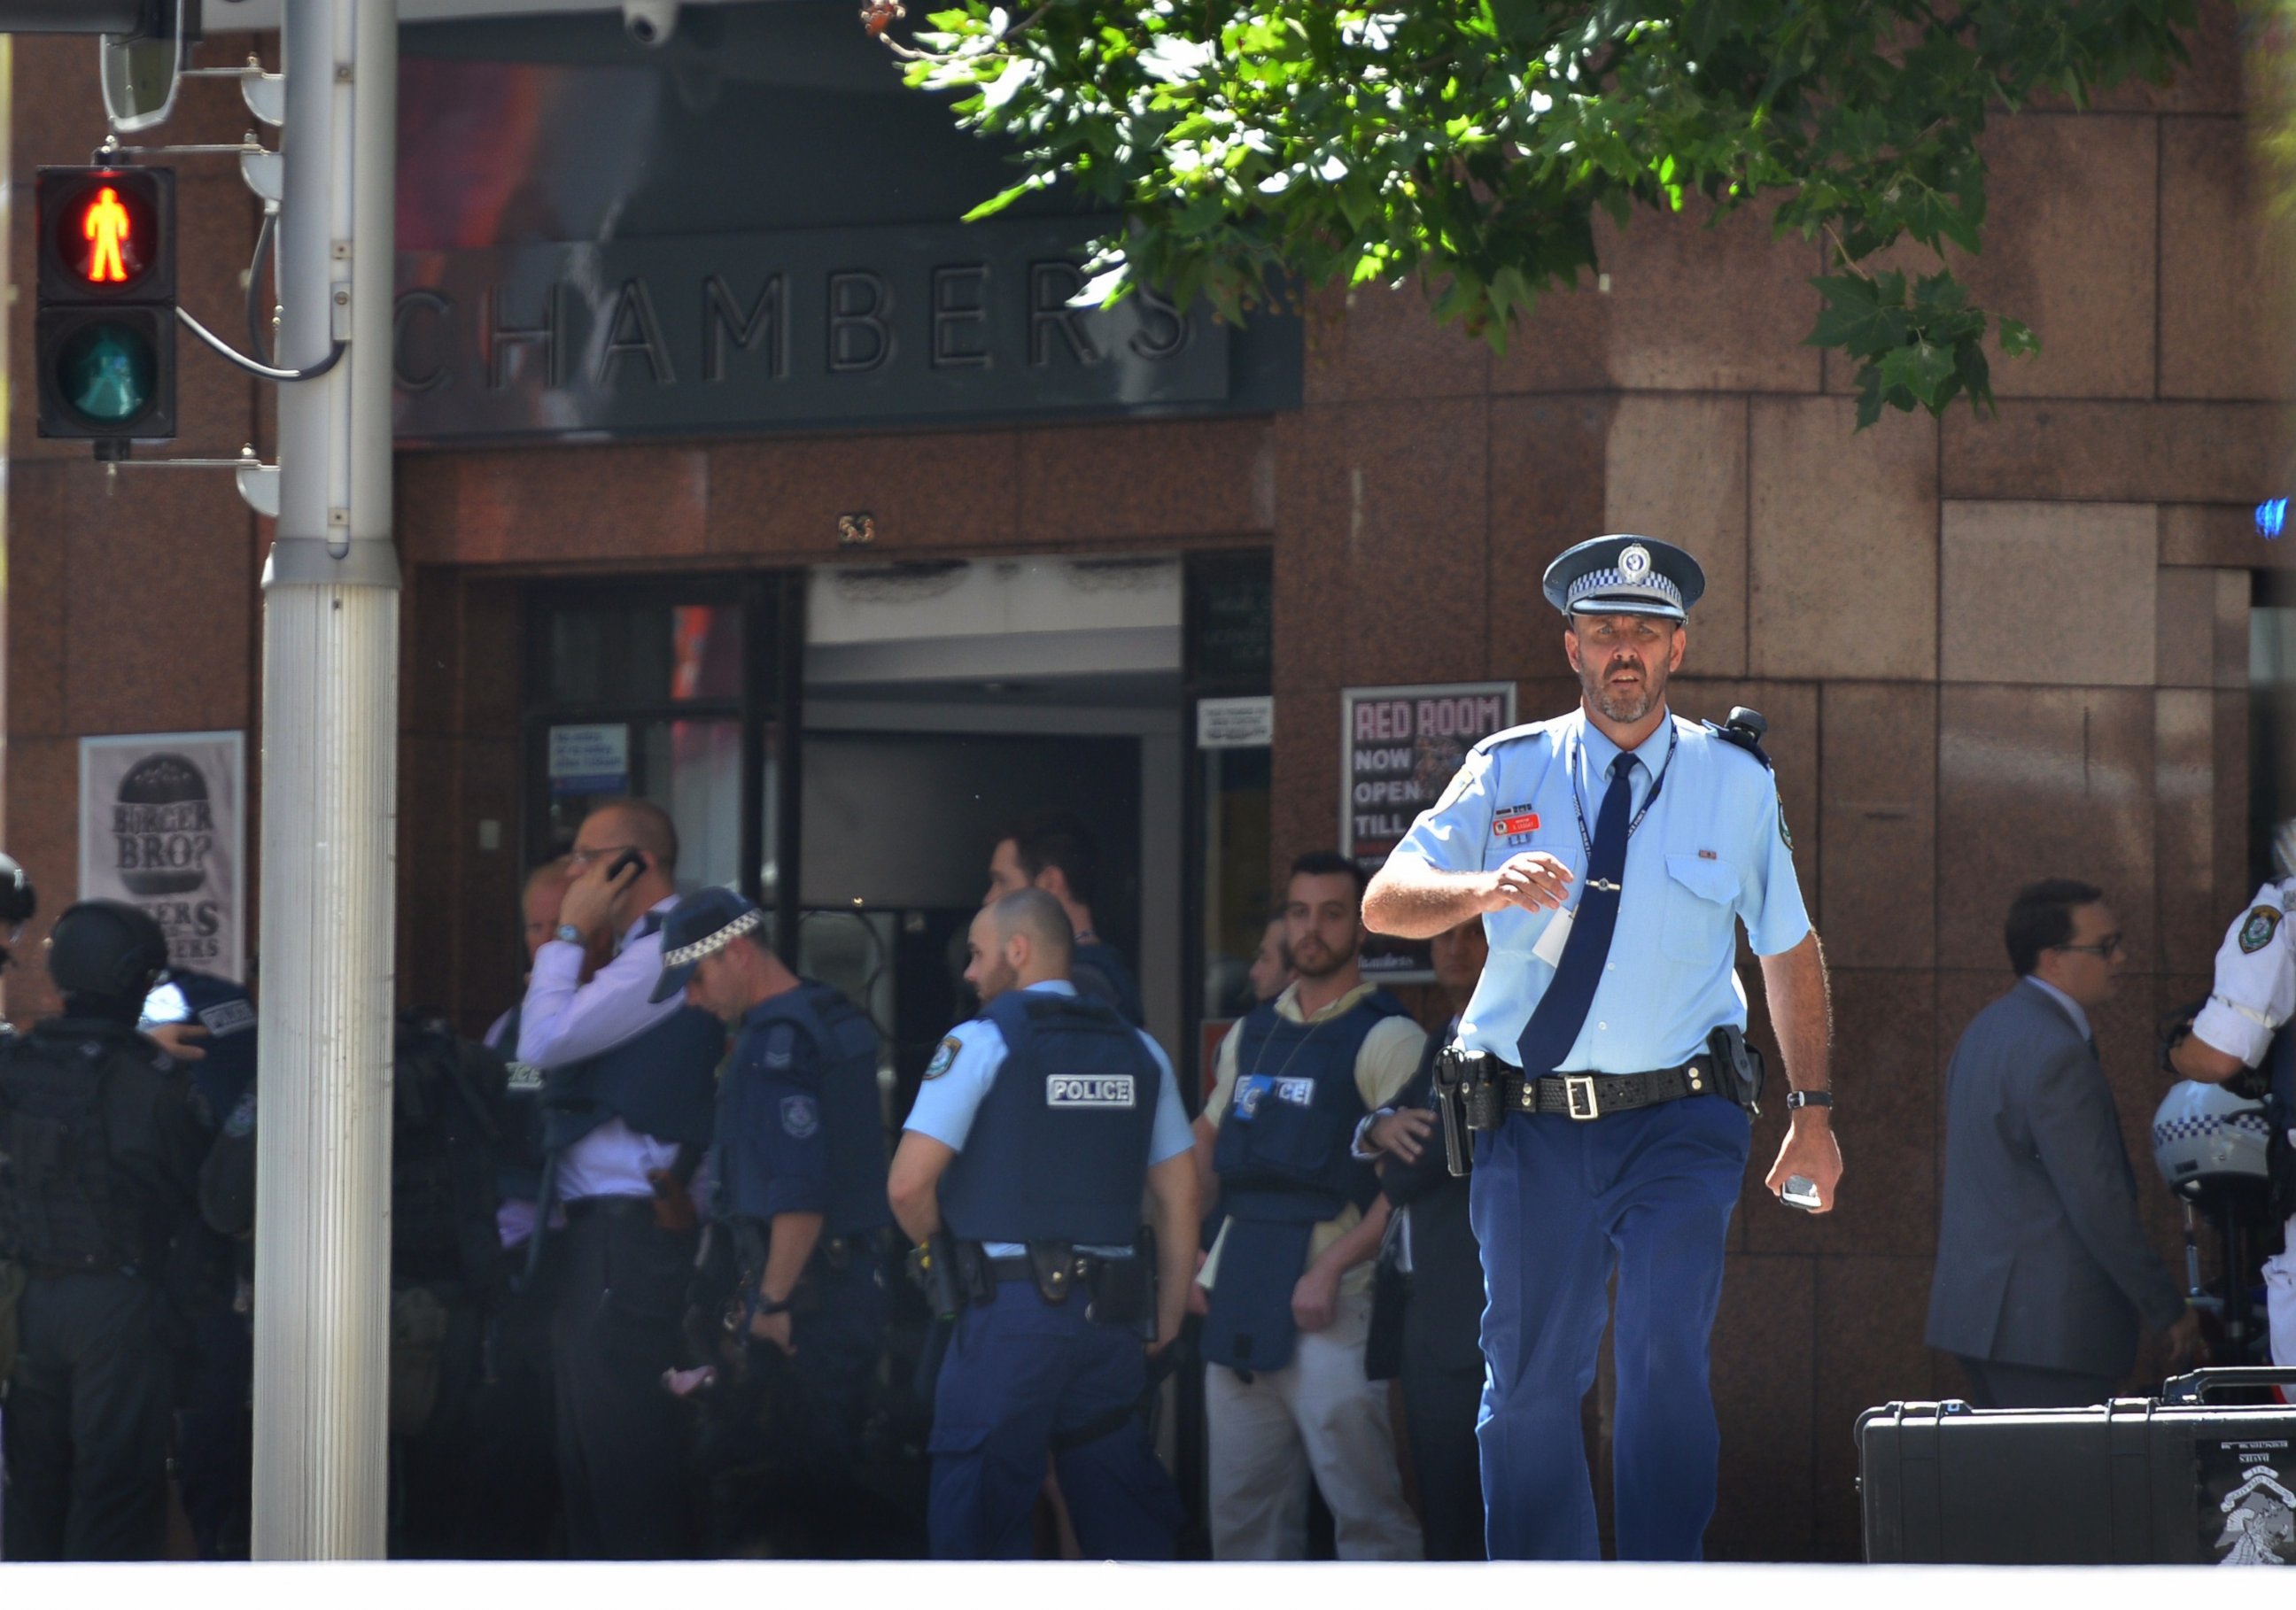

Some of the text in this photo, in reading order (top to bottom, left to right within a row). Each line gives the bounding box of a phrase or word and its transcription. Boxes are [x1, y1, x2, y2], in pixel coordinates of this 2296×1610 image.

[394, 259, 1194, 392] CHAMBERS
[1355, 695, 1501, 740] RED ROOM
[1354, 747, 1412, 770] NOW
[1354, 780, 1422, 803] OPEN
[112, 800, 213, 834] BURGER
[1354, 813, 1407, 836] TILL
[116, 833, 213, 869] BRO?
[1054, 1080, 1129, 1100] POLICE
